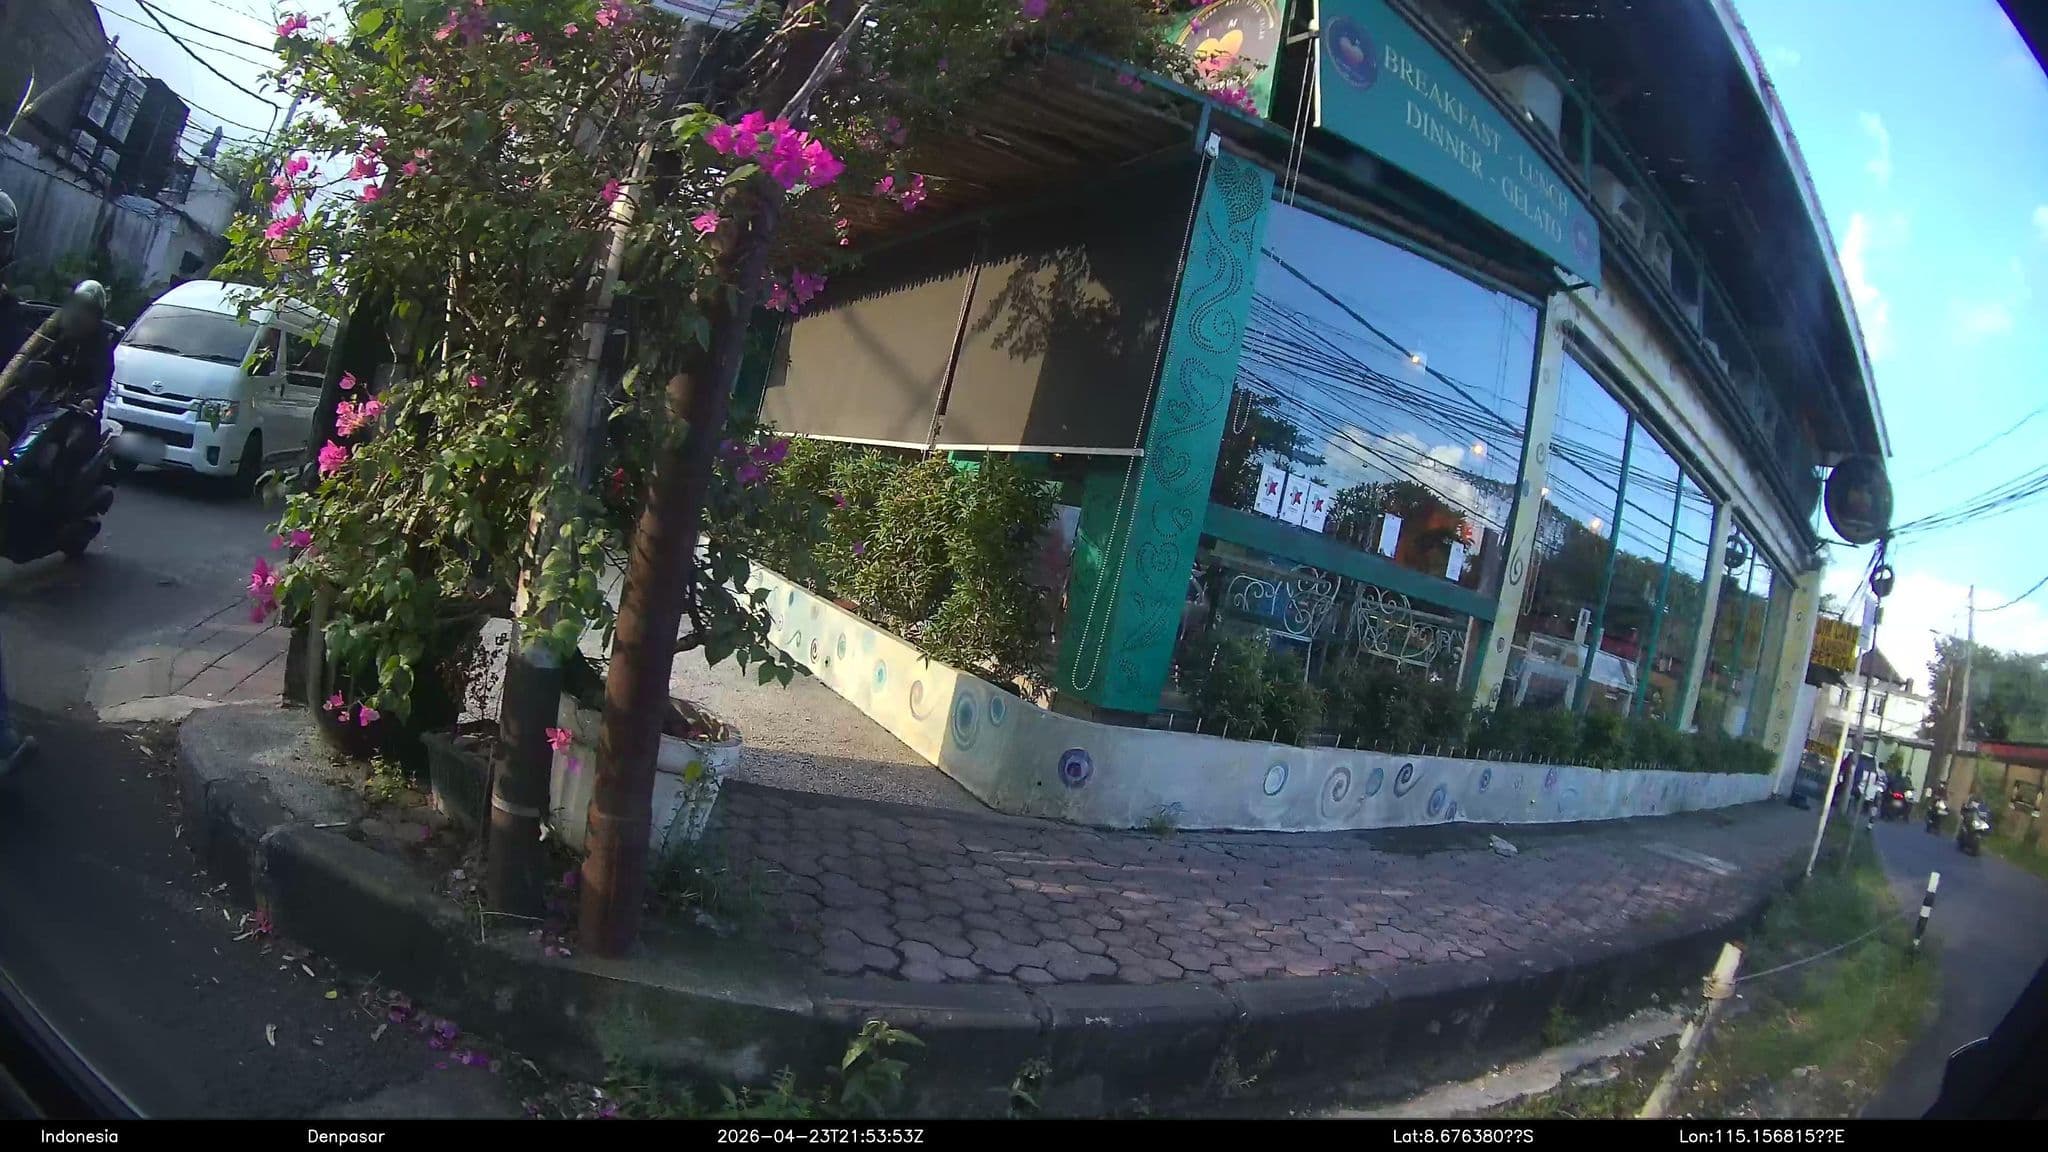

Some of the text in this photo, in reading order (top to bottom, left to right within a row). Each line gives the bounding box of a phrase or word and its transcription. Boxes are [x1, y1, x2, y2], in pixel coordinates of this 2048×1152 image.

[1384, 45, 1500, 153] BREAKFAST
[1519, 154, 1569, 217] LUNCH
[1406, 100, 1484, 180] DINNER
[1502, 175, 1563, 243] GELATO
